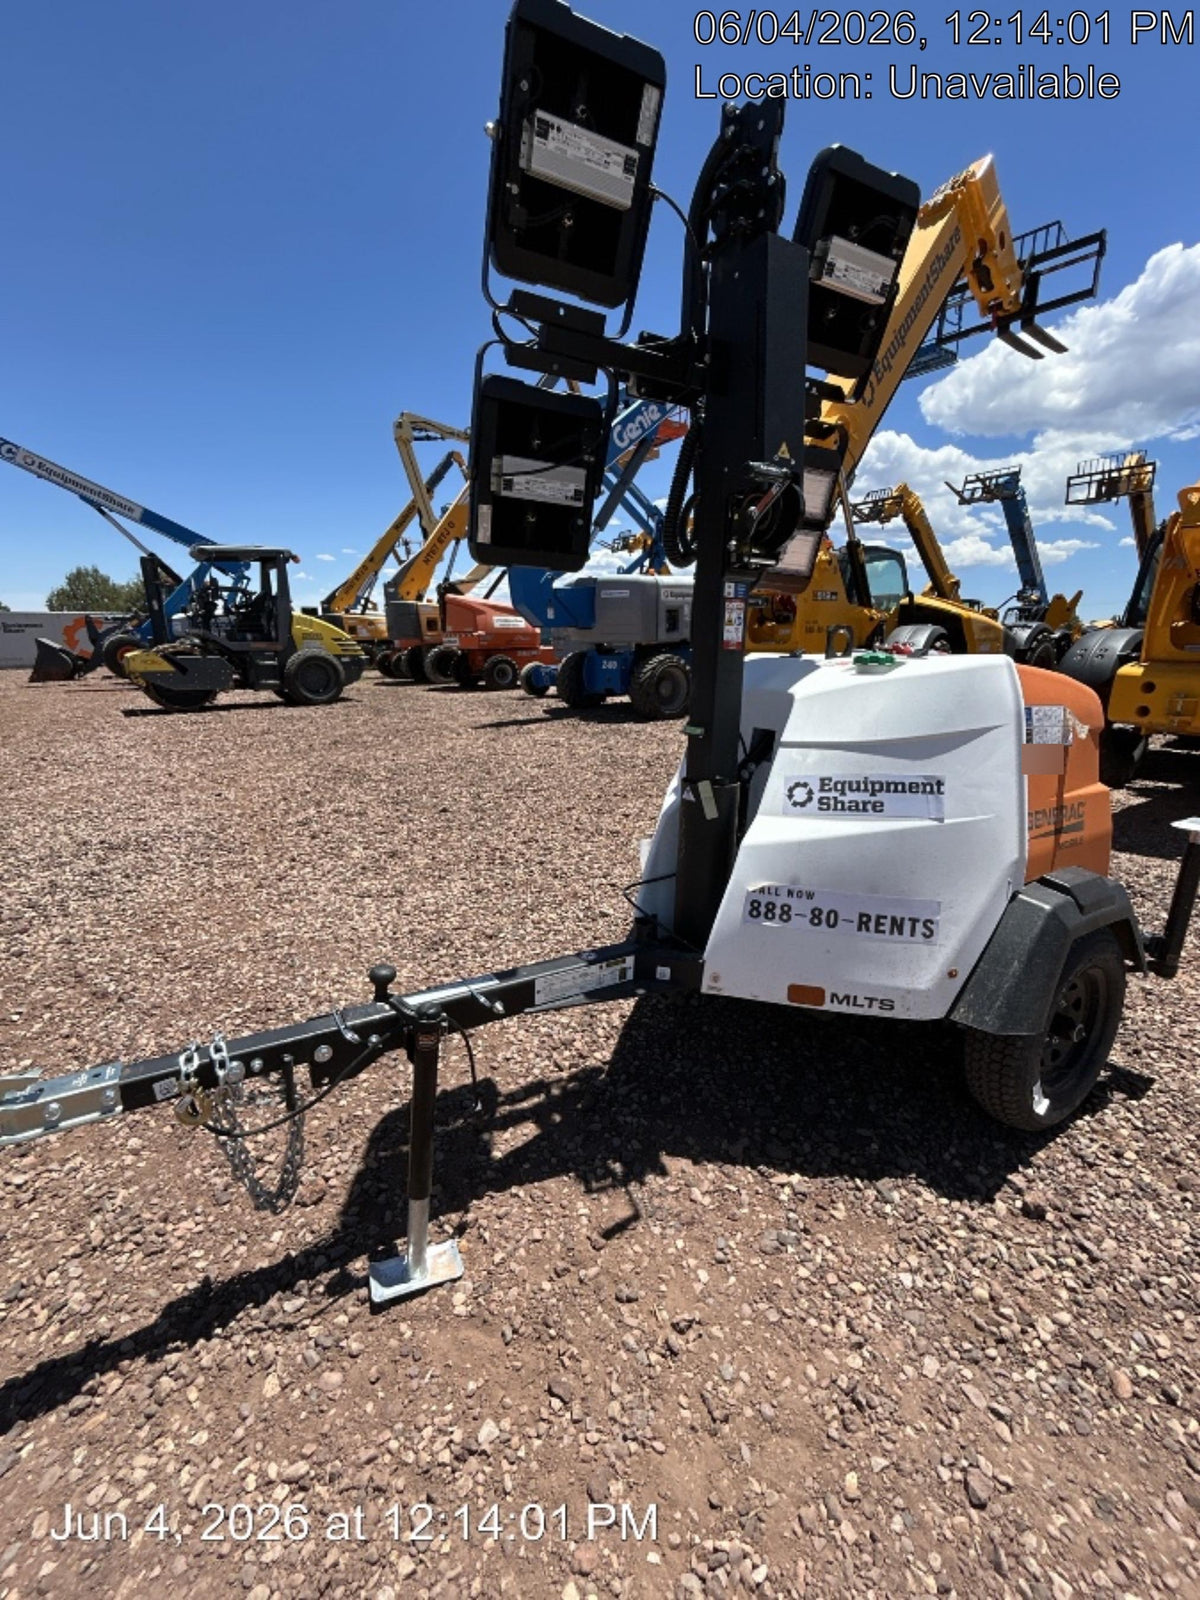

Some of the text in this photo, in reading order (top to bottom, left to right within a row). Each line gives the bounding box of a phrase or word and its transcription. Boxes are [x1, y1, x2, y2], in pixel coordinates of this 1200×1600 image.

[873, 227, 961, 385] EquipmentShare
[612, 404, 662, 449] Genie
[818, 776, 945, 797] Equipment
[817, 795, 885, 813] Share
[1028, 801, 1086, 830] GENERAC
[751, 886, 816, 901] ALL NOW
[748, 898, 935, 940] 888-80-RENTS
[830, 992, 896, 1011] MLTS
